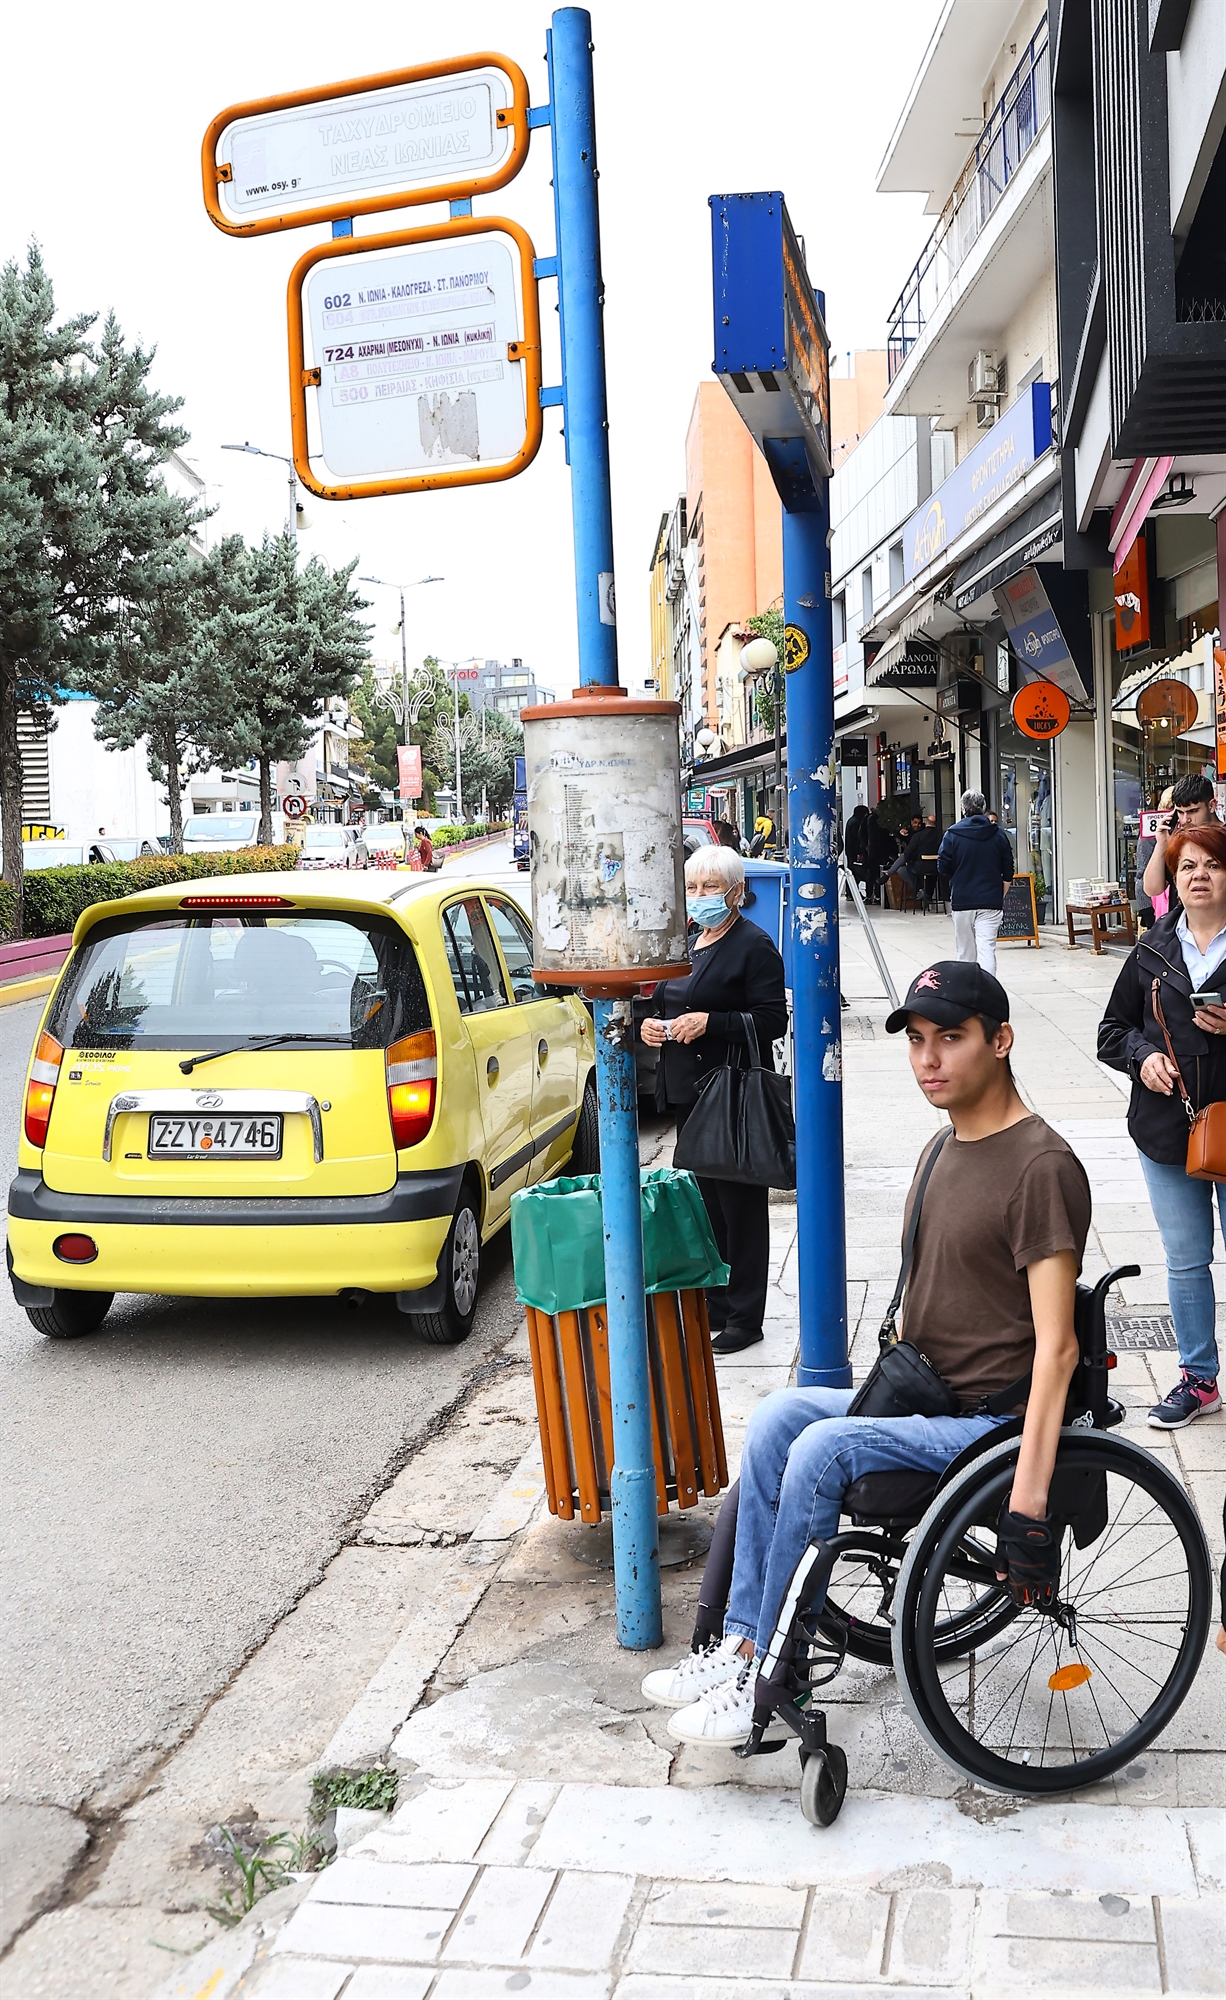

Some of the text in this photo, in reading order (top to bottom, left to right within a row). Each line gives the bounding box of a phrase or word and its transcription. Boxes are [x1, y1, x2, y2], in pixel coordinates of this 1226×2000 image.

[318, 96, 477, 147] ΤΑΧΥΔΡΟΜΕΙΟ
[330, 130, 471, 176] ΝΕΑΣ ΙΩΝΙΑΣ
[324, 293, 352, 310] 602
[367, 288, 387, 303] ΙΩΝΙΑ
[391, 281, 432, 298] ΚΑΛΟΓΡΕΖΑ
[437, 278, 448, 291] ΣΤ.
[449, 271, 489, 289] ΠΑΝΟΡΜΟΥ
[325, 346, 354, 363] 724
[358, 342, 386, 358] ΑΧΑΡΝΑΙ
[386, 337, 424, 356] (ΜΕΣΟΝΥΧΙ)
[440, 332, 460, 346] ΙΩΝΙΑ
